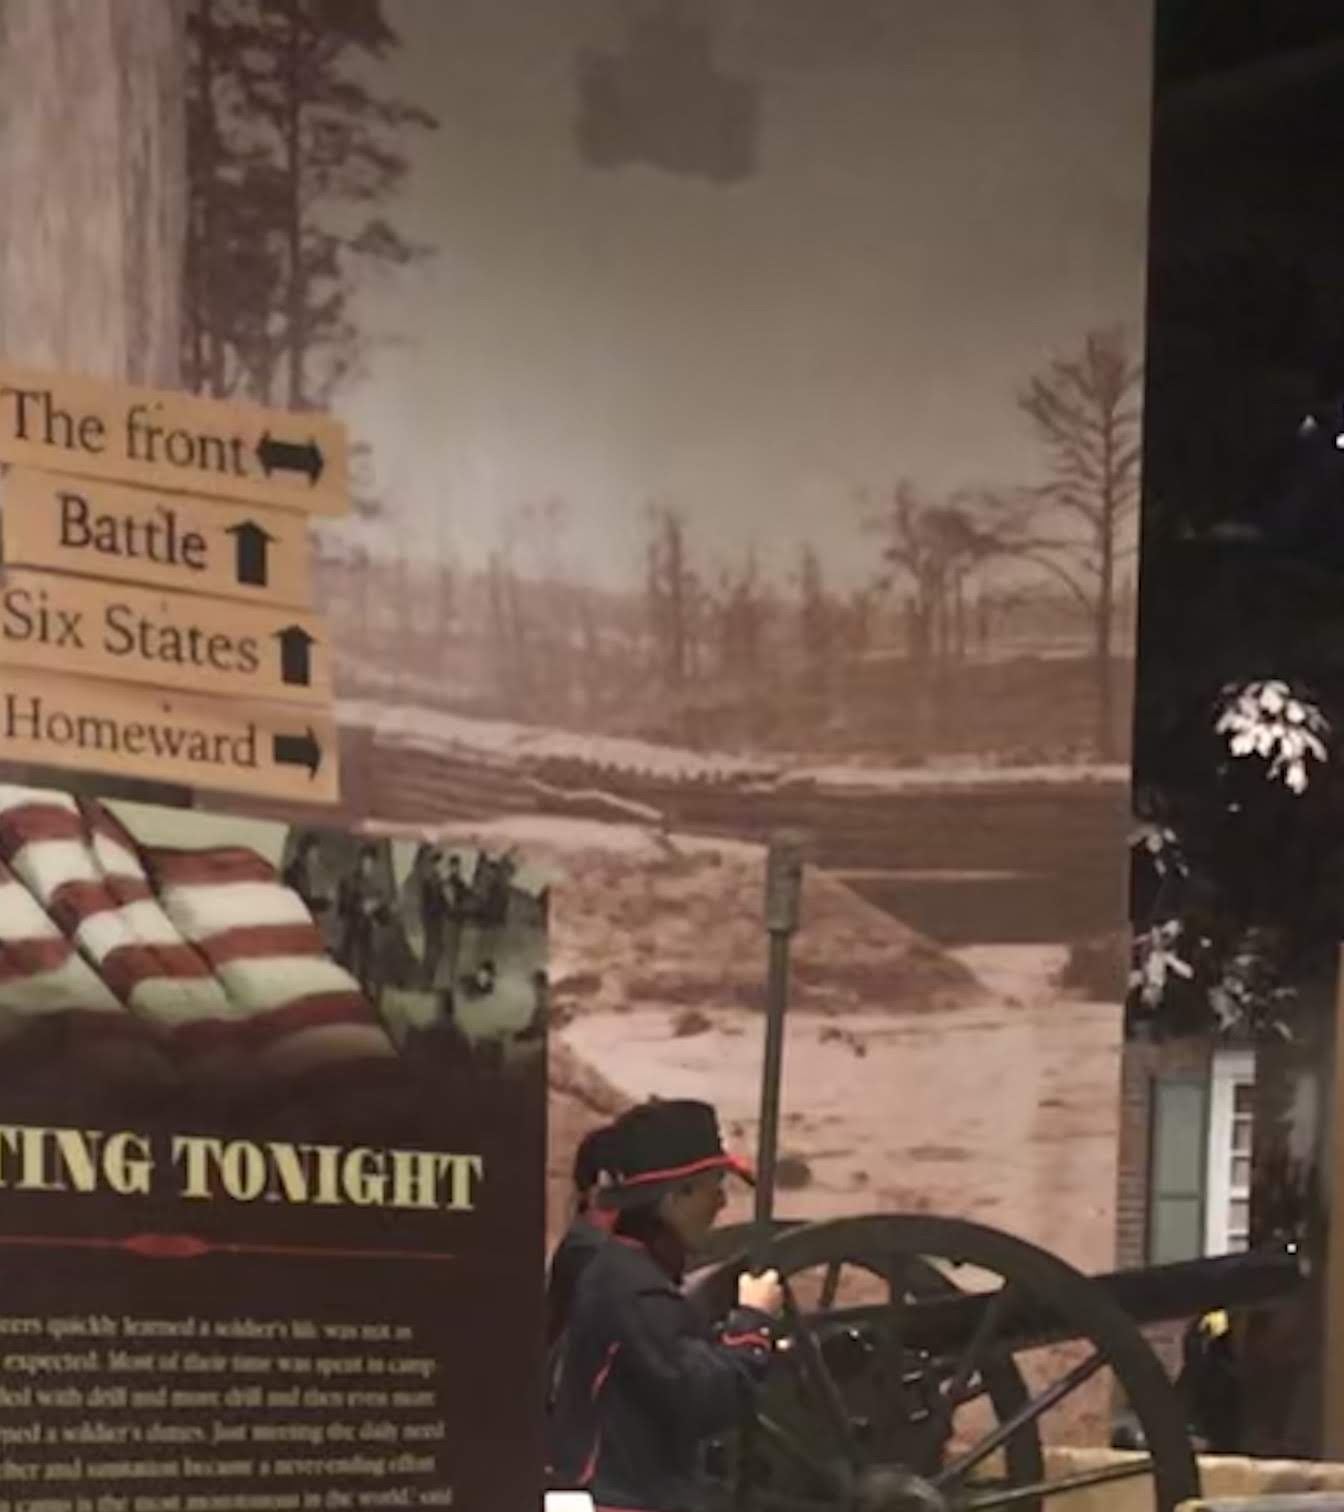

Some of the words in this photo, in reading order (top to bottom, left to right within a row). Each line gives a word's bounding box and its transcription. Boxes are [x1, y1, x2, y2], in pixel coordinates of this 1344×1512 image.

[0, 388, 106, 452] The
[125, 405, 250, 479] front
[56, 491, 209, 570] Battle
[2, 588, 85, 649] Six
[103, 602, 260, 673] States
[3, 692, 258, 768] Homeward
[171, 1135, 484, 1211] TONIGHT
